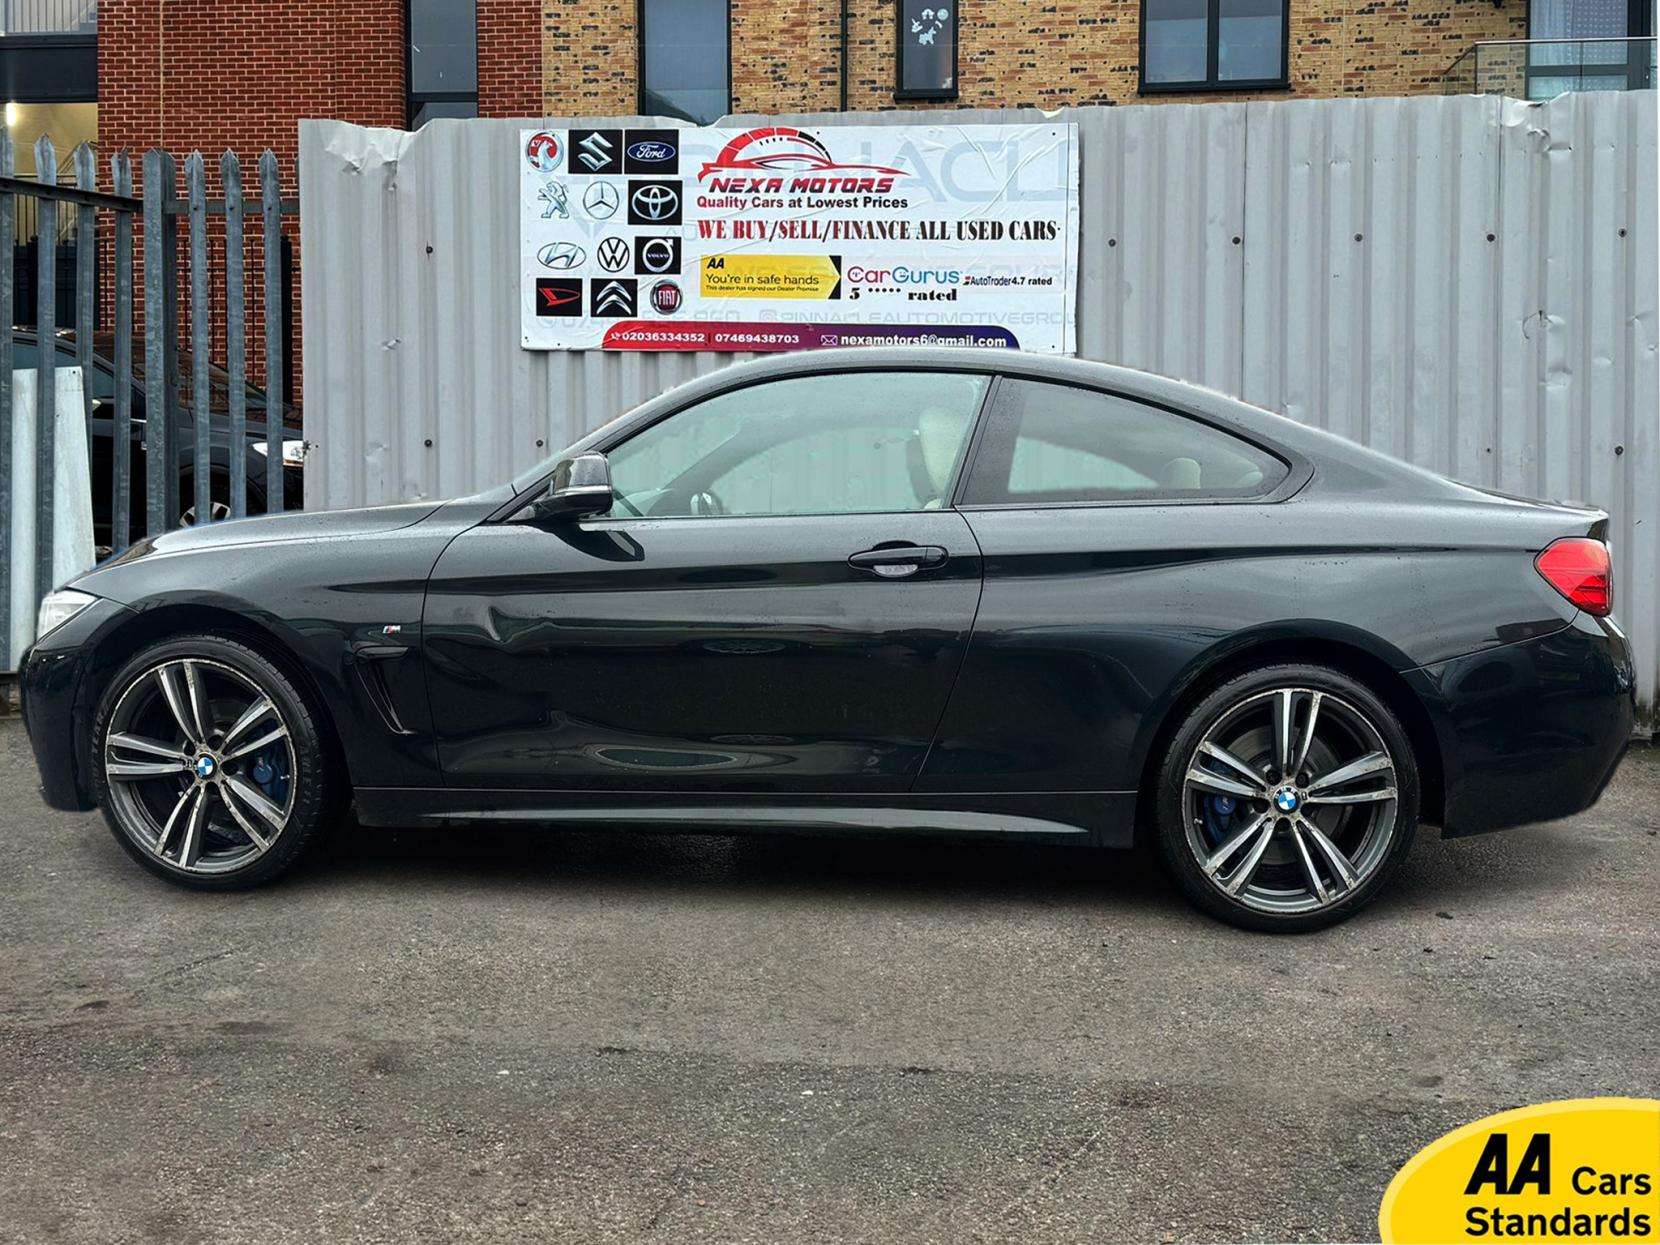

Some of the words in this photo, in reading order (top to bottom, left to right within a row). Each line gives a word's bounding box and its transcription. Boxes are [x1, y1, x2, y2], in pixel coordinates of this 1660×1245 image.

[635, 144, 666, 159] Ford
[709, 178, 783, 193] NEXA
[789, 178, 894, 193] MOTORS
[697, 196, 747, 210] Quality
[751, 197, 784, 208] Cars
[788, 197, 802, 208] at
[807, 196, 858, 208] Lowest
[863, 197, 908, 208] Prices
[697, 220, 726, 240] WE
[733, 219, 910, 242] BUY/SELL/FINANCE
[916, 221, 950, 240] ALL
[957, 221, 1004, 240] USED
[1008, 221, 1056, 240] CARS
[707, 258, 725, 269] AA
[706, 274, 741, 284] You're
[744, 274, 754, 284] in
[757, 274, 781, 284] safe
[784, 275, 819, 285] hands
[847, 266, 960, 283] CarGurus
[1028, 277, 1053, 286] rated
[658, 289, 676, 306] FIAT
[850, 287, 860, 300] 5
[908, 288, 957, 301] rated
[622, 333, 705, 342] 02036334352
[715, 333, 799, 343] 07469438703
[840, 334, 1006, 347] nexamotors6@gmail.com
